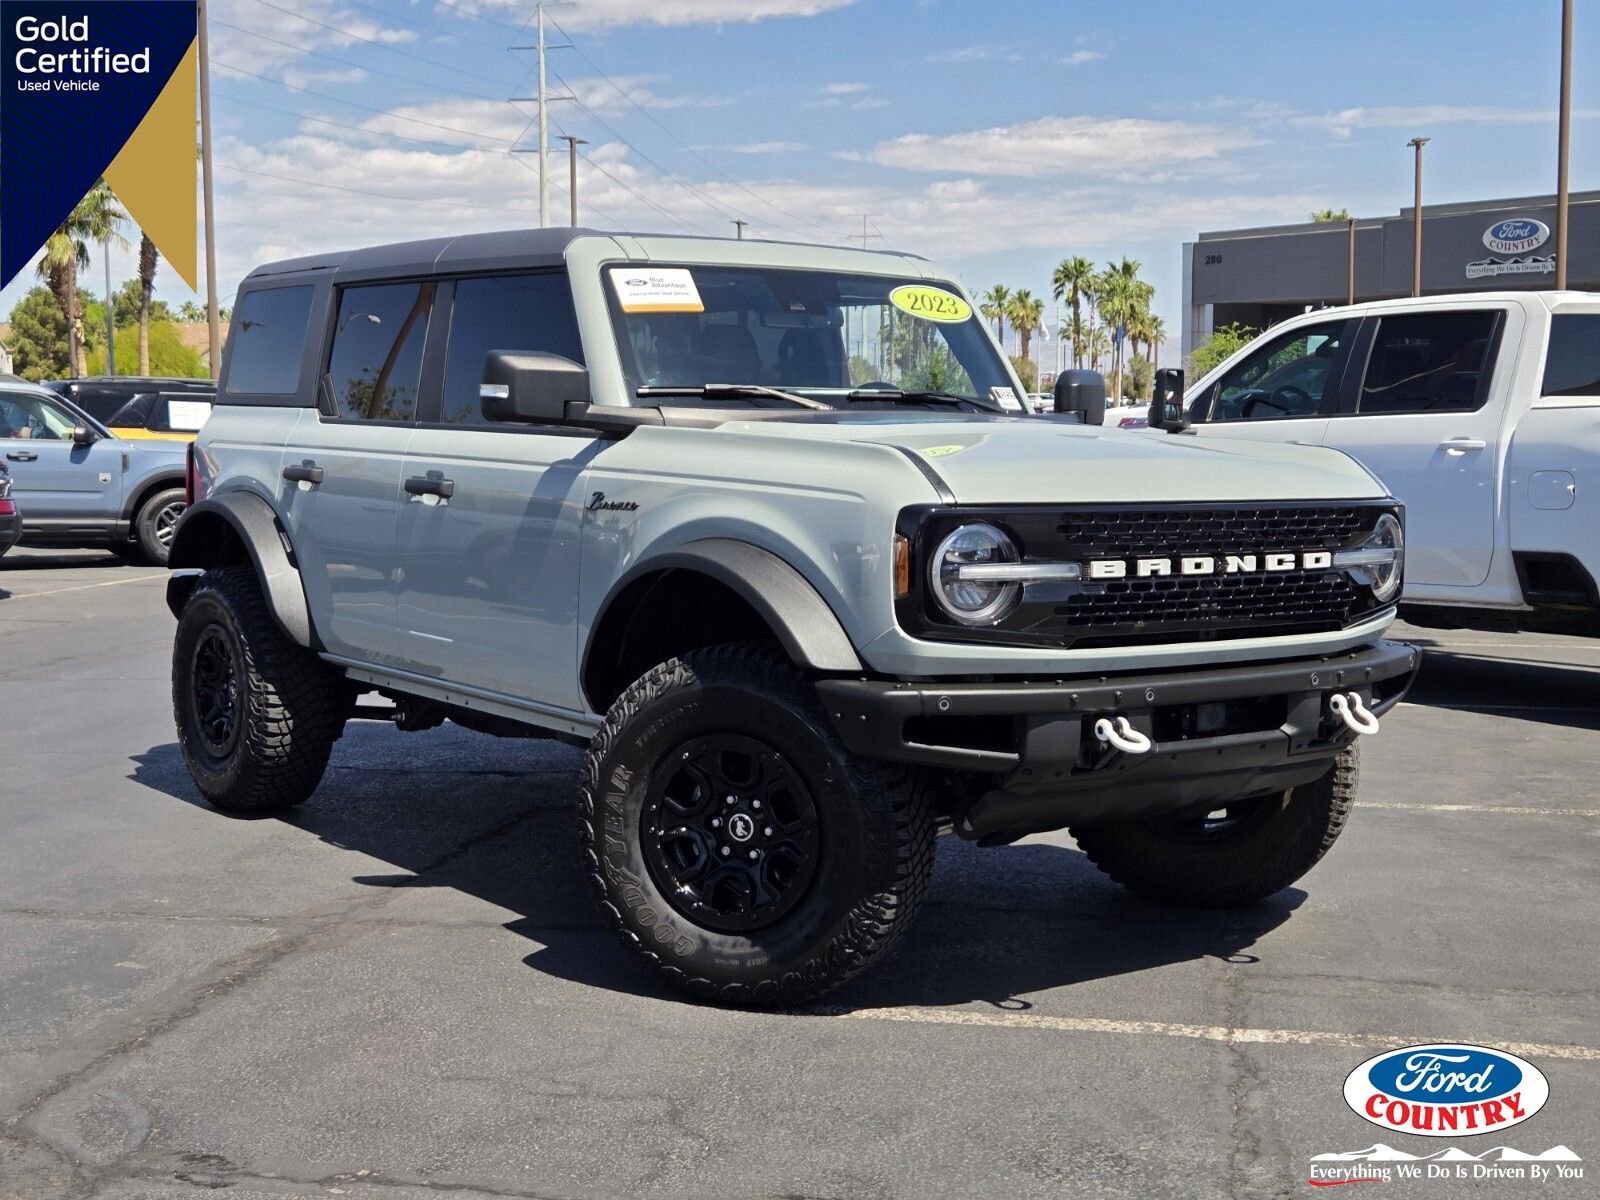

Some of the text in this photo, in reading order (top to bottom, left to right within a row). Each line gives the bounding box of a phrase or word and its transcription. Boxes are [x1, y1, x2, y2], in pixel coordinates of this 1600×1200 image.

[1498, 222, 1531, 238] Ford
[1489, 235, 1541, 251] COUNTRY
[1468, 265, 1495, 274] Everything
[1521, 263, 1540, 271] Driven
[1541, 263, 1549, 272] By
[907, 292, 959, 315] 2023
[585, 490, 640, 511] Bronco
[1090, 551, 1332, 578] BRONCO
